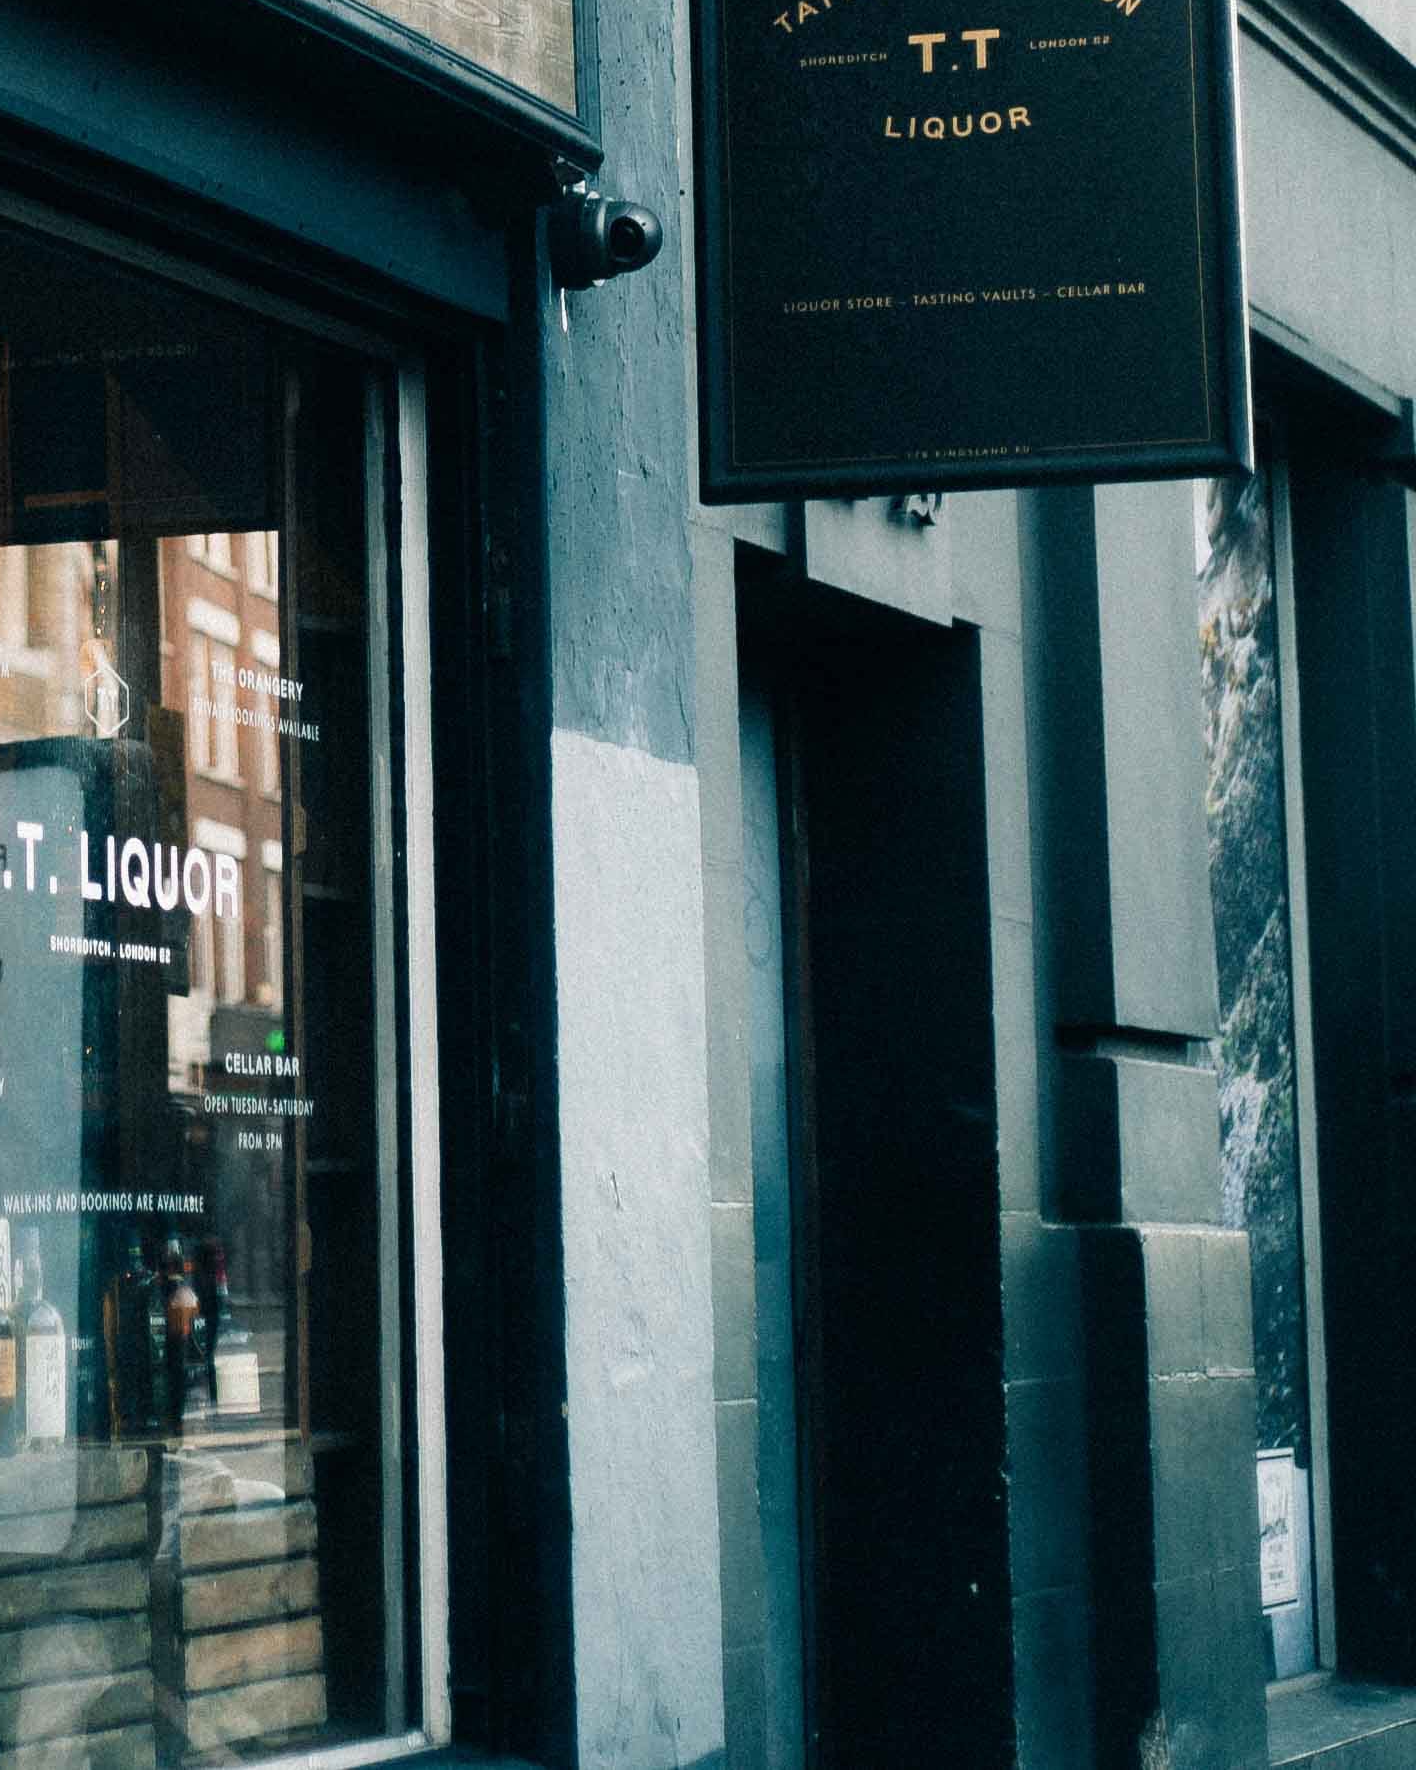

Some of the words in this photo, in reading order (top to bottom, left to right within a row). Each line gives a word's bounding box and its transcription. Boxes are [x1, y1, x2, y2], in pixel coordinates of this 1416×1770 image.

[908, 29, 1000, 73] T.T
[1029, 37, 1087, 50] LONDON
[885, 106, 1032, 139] LIQUOR
[784, 299, 841, 313] LIQUOR
[847, 296, 894, 310] STORE
[913, 292, 975, 307] TASTING
[983, 288, 1036, 303] VAULTS
[1057, 283, 1112, 299] CELLAR
[1118, 282, 1145, 296] BAR
[238, 668, 303, 702] ORANGERY
[279, 717, 320, 741] AVAILABLE
[80, 831, 239, 918] LIQUOR
[119, 943, 157, 963] LONDON
[225, 1052, 272, 1076] CELLAR
[275, 1055, 300, 1077] BAR
[204, 1095, 229, 1113] OPEN
[238, 1132, 263, 1150] FROM
[265, 1133, 283, 1150] 5PM
[4, 1193, 52, 1214] WALK-INS
[56, 1193, 77, 1214] AND
[81, 1193, 133, 1212] BOOKINGS
[137, 1194, 154, 1212] ARE
[157, 1194, 204, 1213] AVAILABLE
